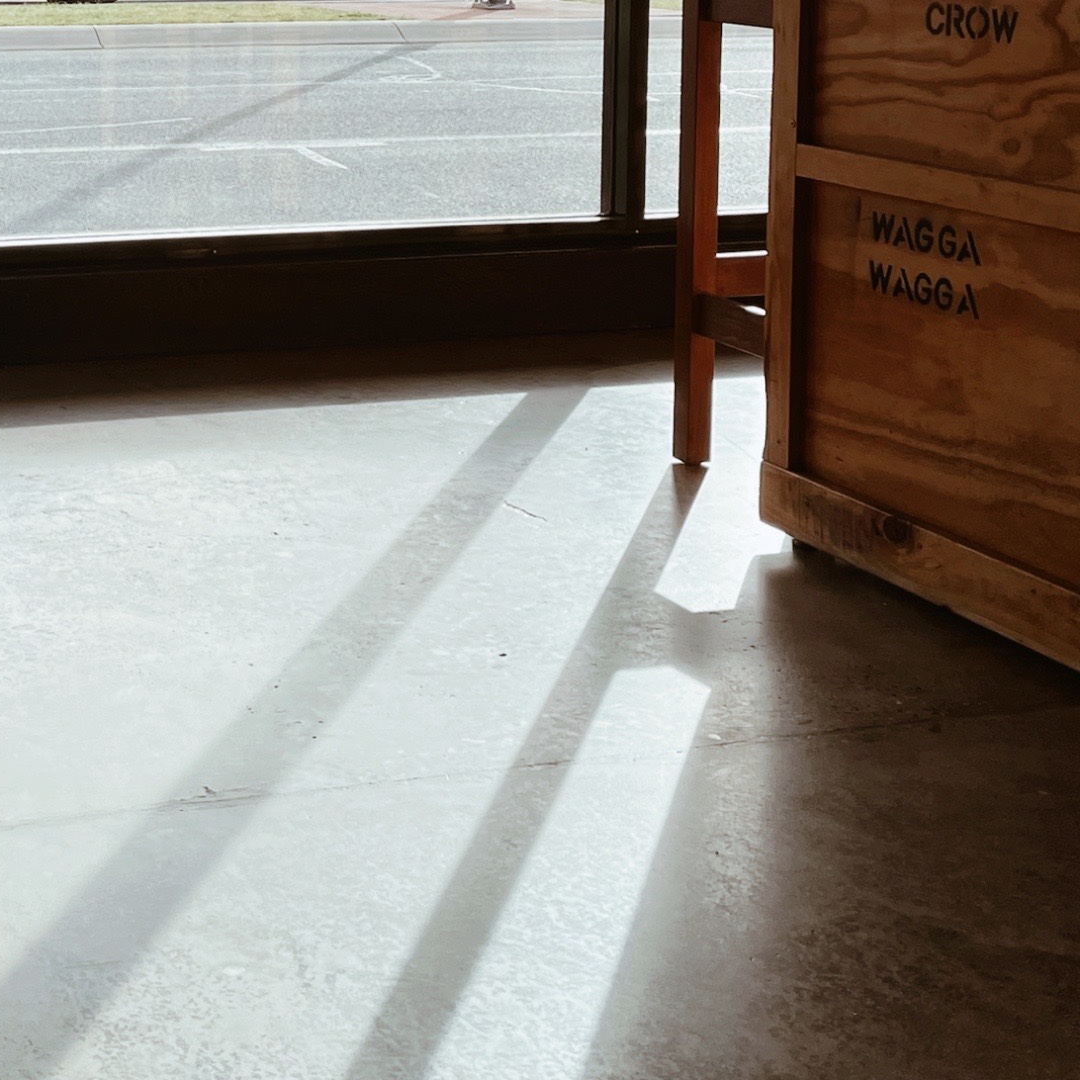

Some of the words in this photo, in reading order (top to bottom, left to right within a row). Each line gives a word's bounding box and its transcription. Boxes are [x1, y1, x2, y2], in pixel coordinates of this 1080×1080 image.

[925, 1, 1019, 44] CROW
[872, 210, 982, 267] WAGGA
[869, 259, 980, 320] WAGGA
